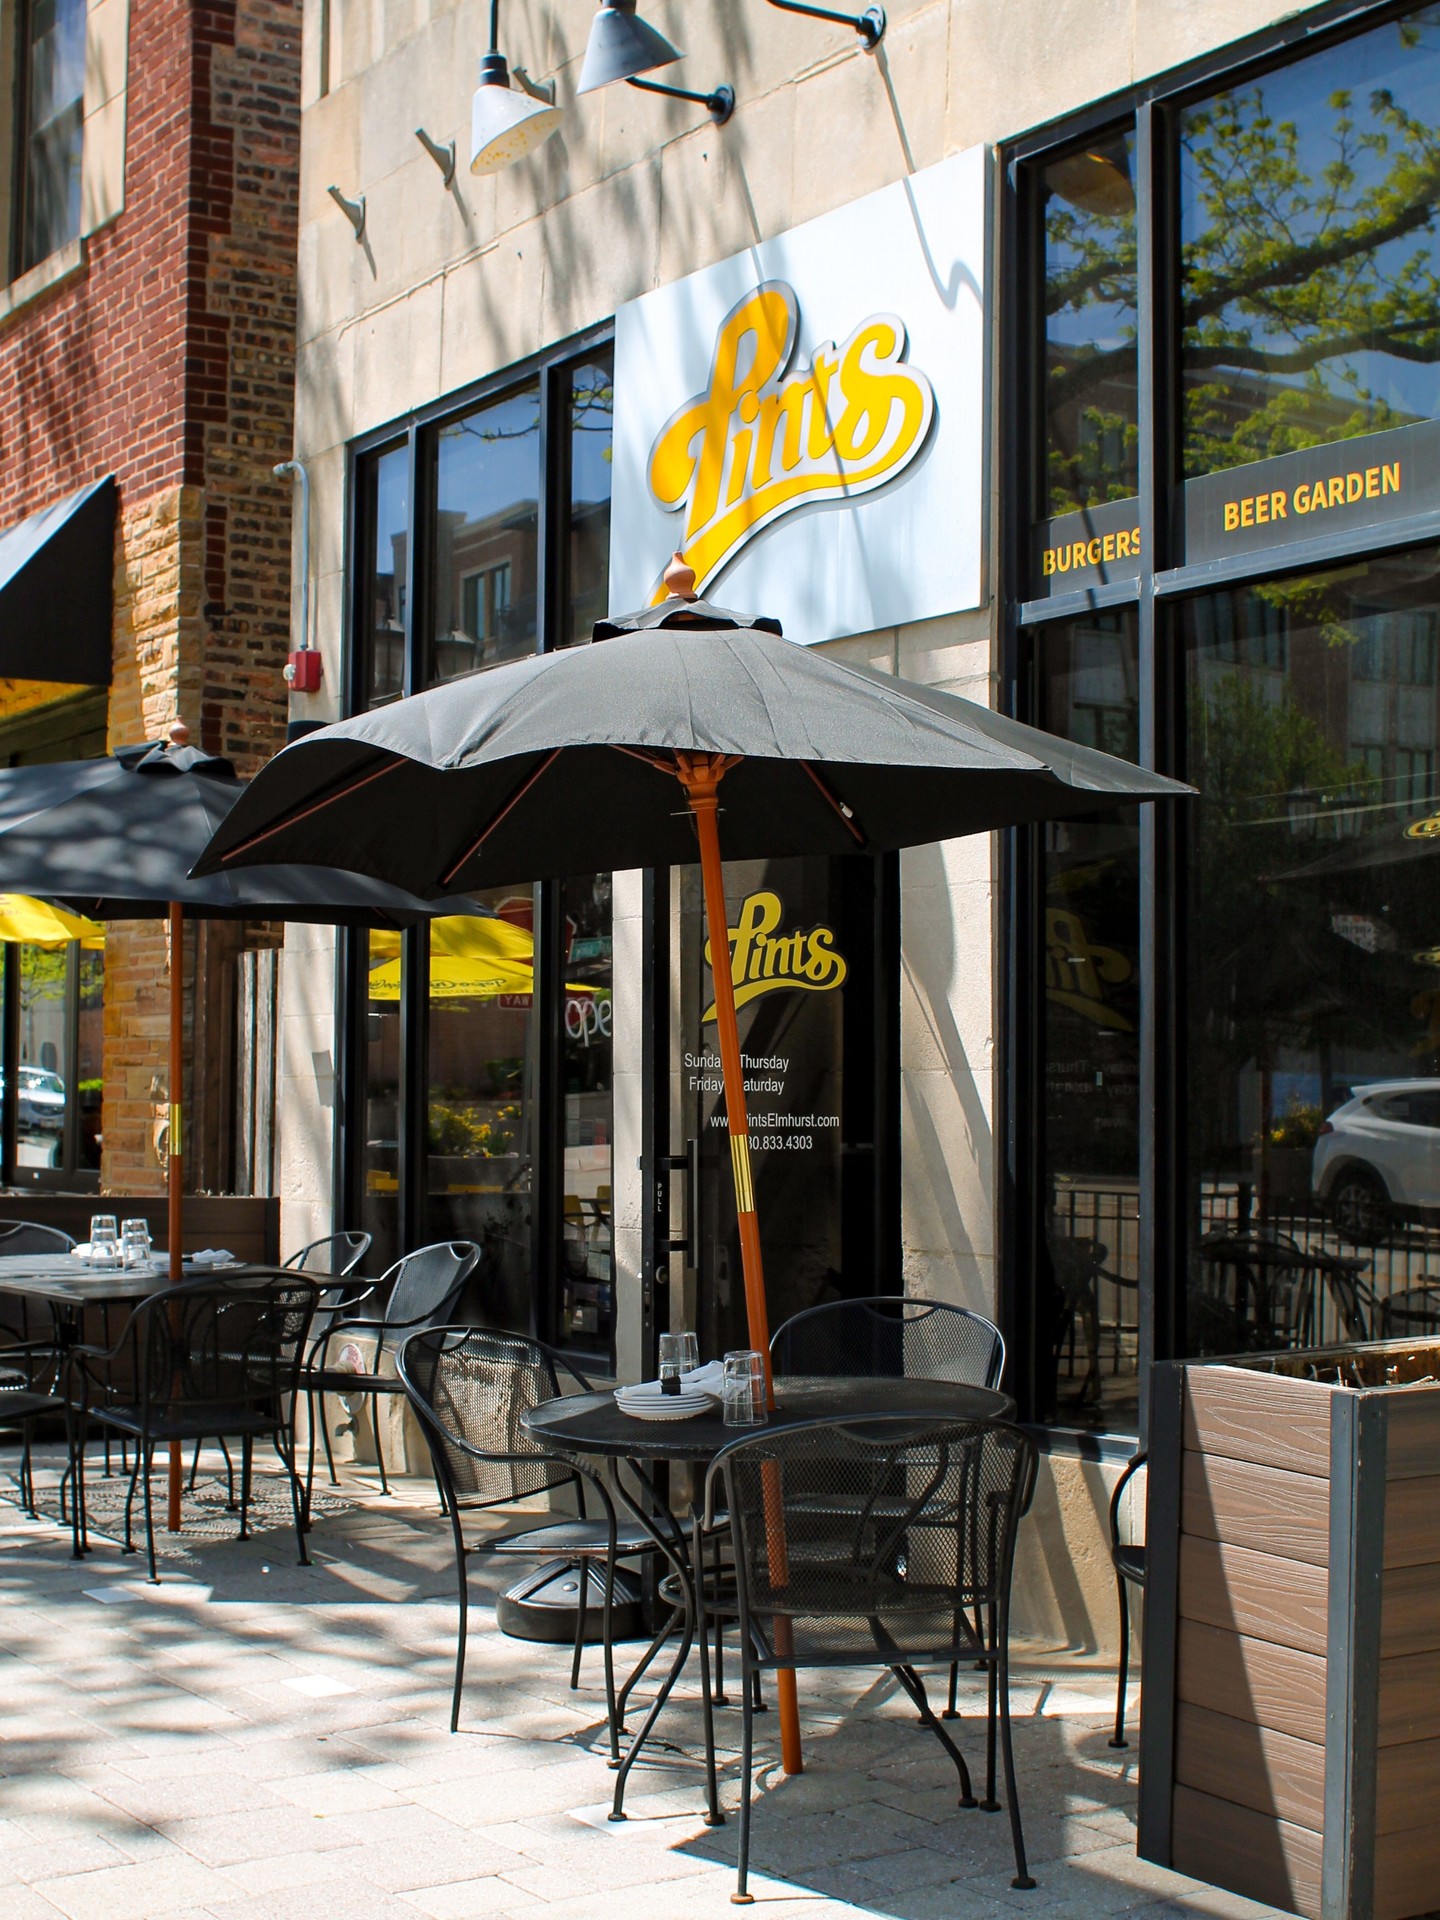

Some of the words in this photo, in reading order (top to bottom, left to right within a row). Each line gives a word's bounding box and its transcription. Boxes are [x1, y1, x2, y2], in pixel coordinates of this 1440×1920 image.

[649, 285, 933, 606] Pints
[1224, 490, 1287, 532] BEER
[1293, 461, 1401, 515] GARDEN
[1042, 526, 1140, 576] BURGERS
[702, 891, 847, 1023] Pints
[565, 1000, 611, 1047] ope
[684, 1052, 723, 1071] Sunda
[740, 1054, 789, 1072] Thursday
[689, 1076, 724, 1094] Friday
[743, 1078, 784, 1095] aturday
[710, 1112, 840, 1128] wwintsElmhurst.com
[748, 1135, 813, 1150] 30.833.4303
